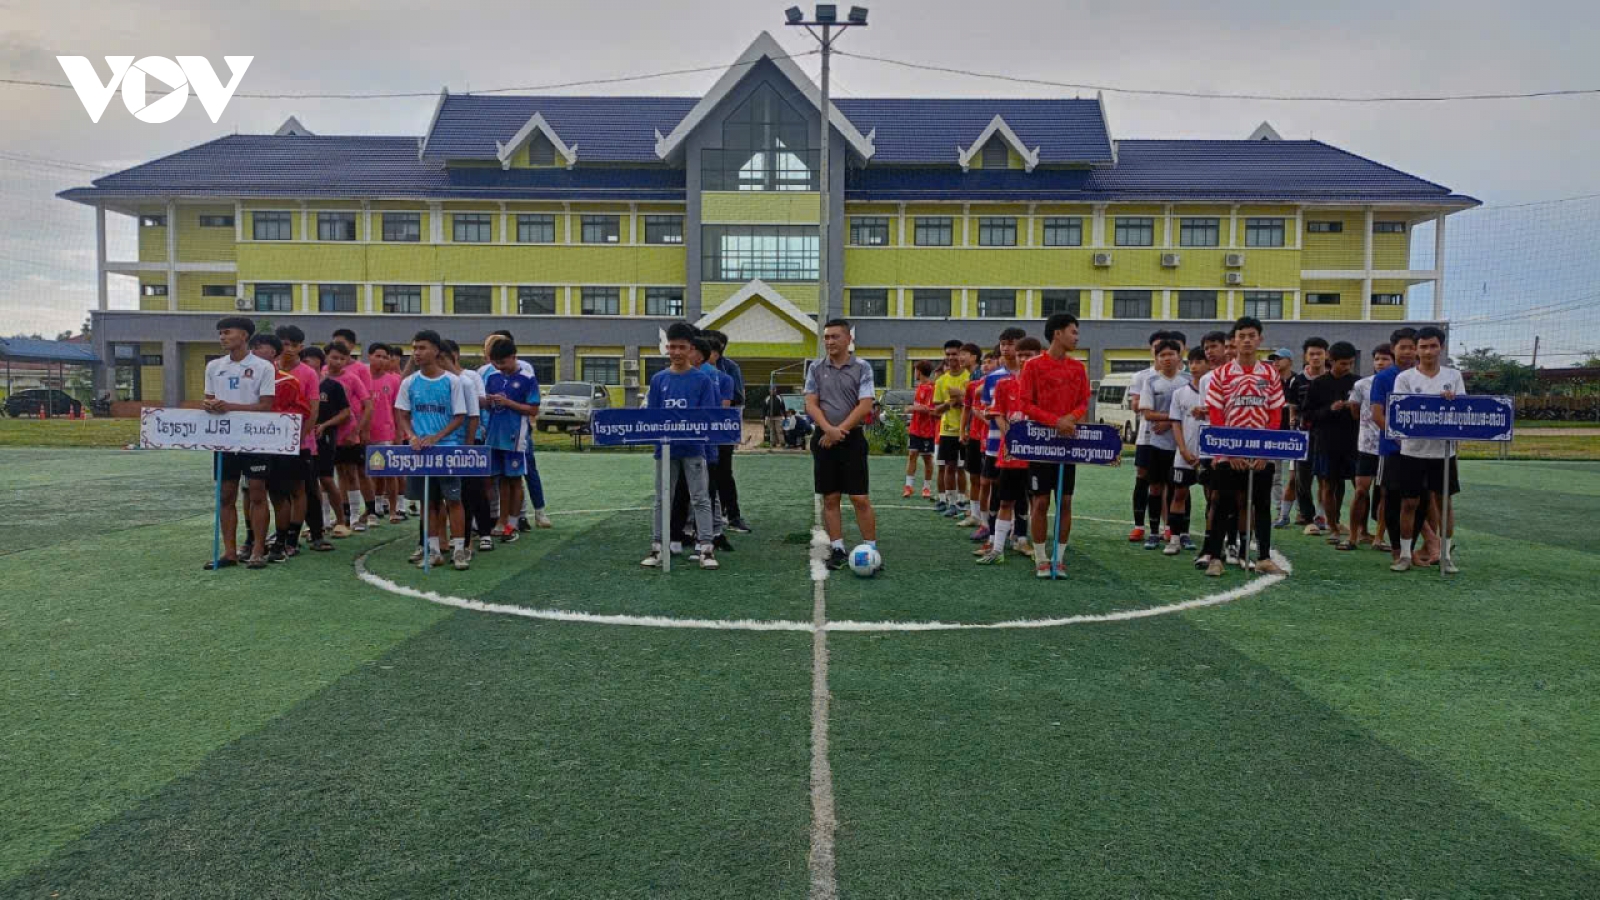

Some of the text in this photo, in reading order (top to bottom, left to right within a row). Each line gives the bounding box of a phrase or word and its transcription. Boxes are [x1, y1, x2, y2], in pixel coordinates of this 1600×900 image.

[228, 376, 240, 390] 12
[156, 417, 197, 438] ໂຮງຮຽນ
[594, 421, 632, 436] ໂຮງຮຽນ
[1204, 434, 1242, 450] ໂຮງຮຽນ
[386, 449, 424, 471] ໂຮງຮຽນ
